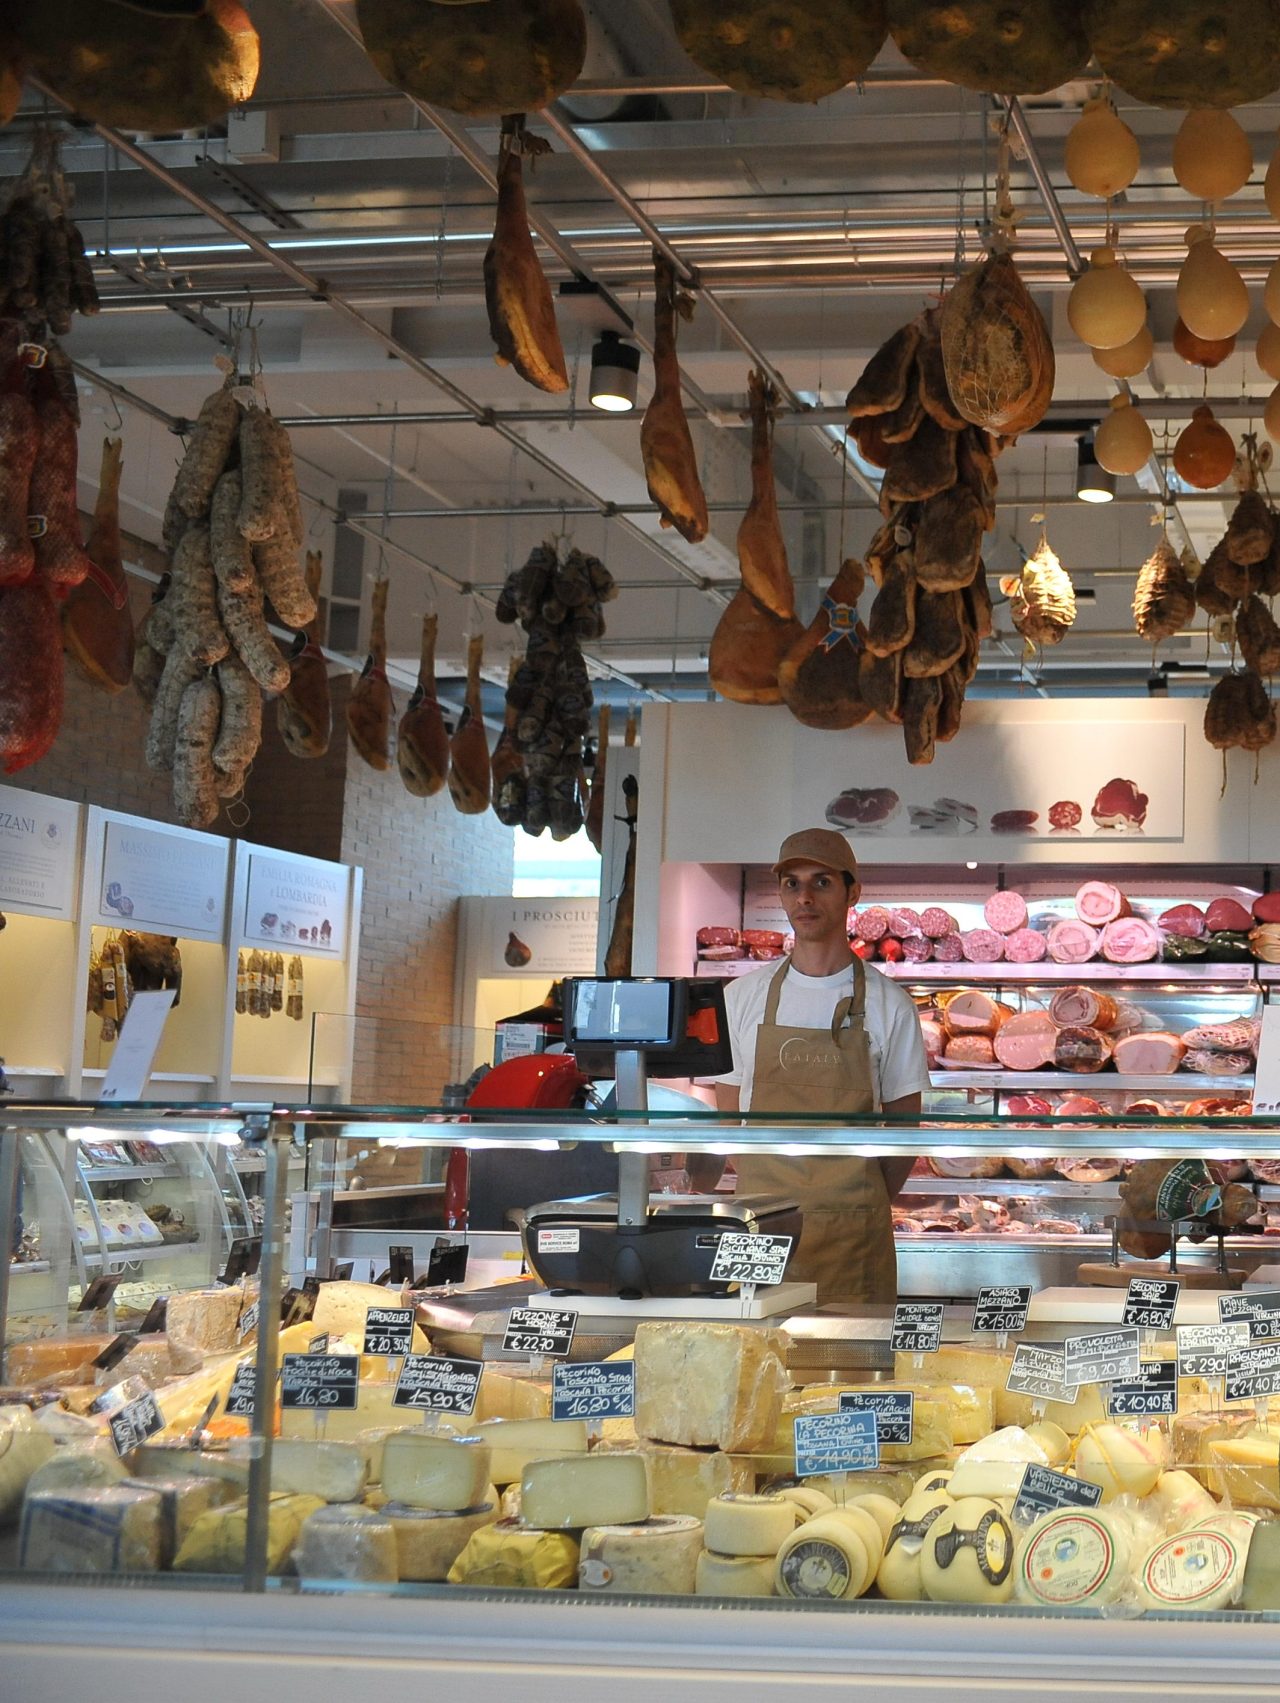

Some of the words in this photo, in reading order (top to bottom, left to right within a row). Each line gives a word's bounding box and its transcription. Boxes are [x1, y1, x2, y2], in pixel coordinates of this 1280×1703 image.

[723, 1234, 773, 1246] PECORINO
[989, 1288, 1019, 1297] ASIAGO
[1131, 1280, 1167, 1293] SECONDO
[1222, 1298, 1248, 1307] PIAVE
[1225, 1304, 1263, 1314] MEZZANO
[512, 1310, 560, 1322] PUZZONE
[1181, 1327, 1228, 1339] PECORINO
[1230, 1347, 1275, 1364] RAGUSANO
[800, 1416, 851, 1430] PECORINO
